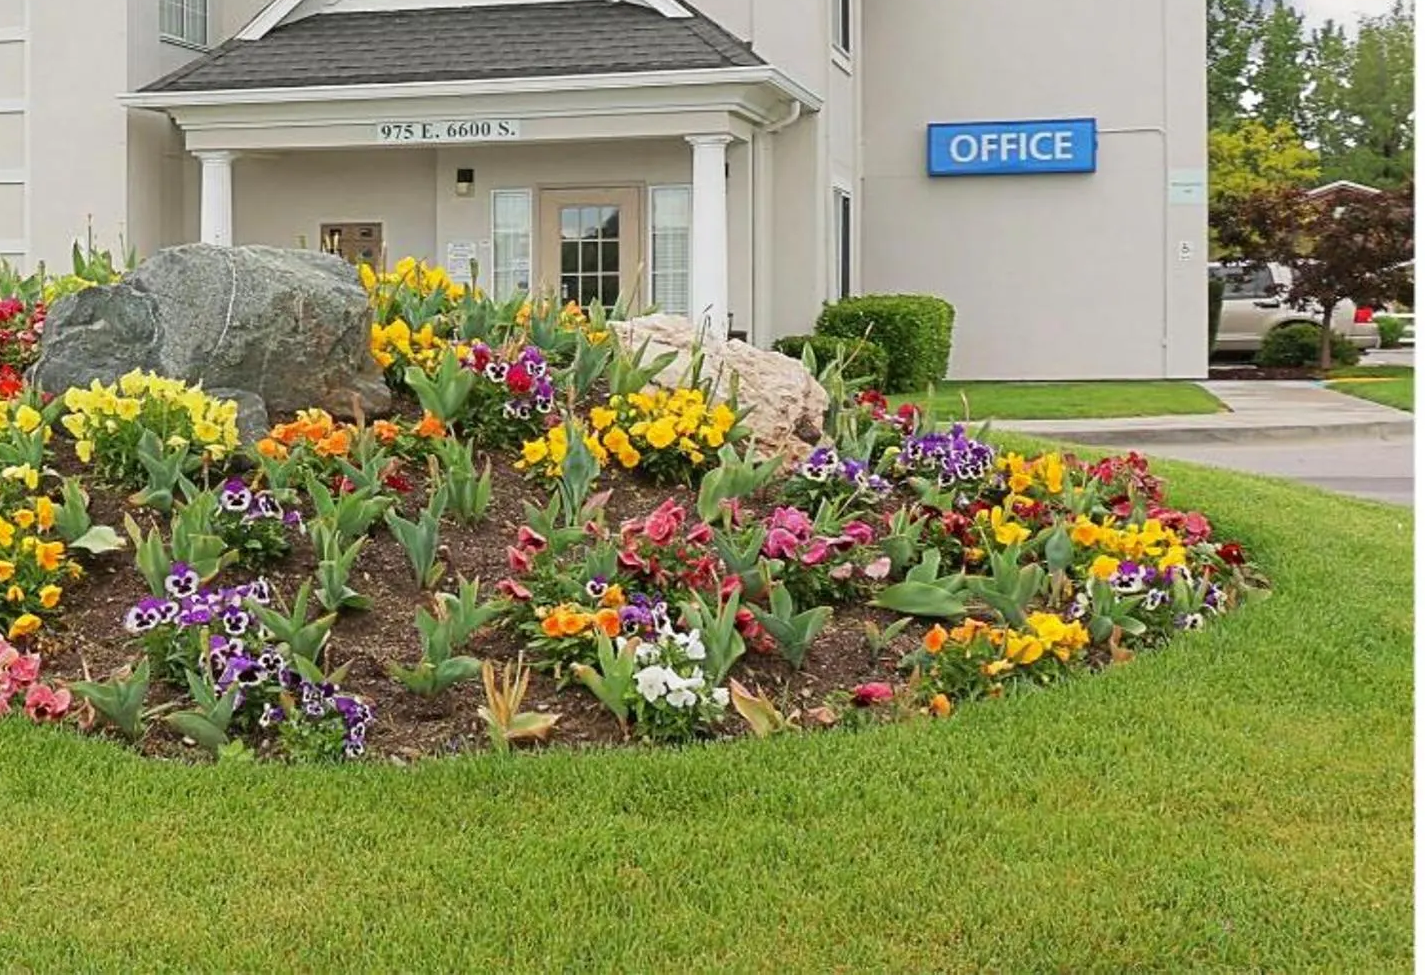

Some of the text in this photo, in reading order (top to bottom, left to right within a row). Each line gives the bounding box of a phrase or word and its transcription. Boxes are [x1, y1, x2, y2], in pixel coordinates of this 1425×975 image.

[381, 121, 516, 140] 975 E. 6600 S.
[949, 131, 1073, 163] OFFICE
